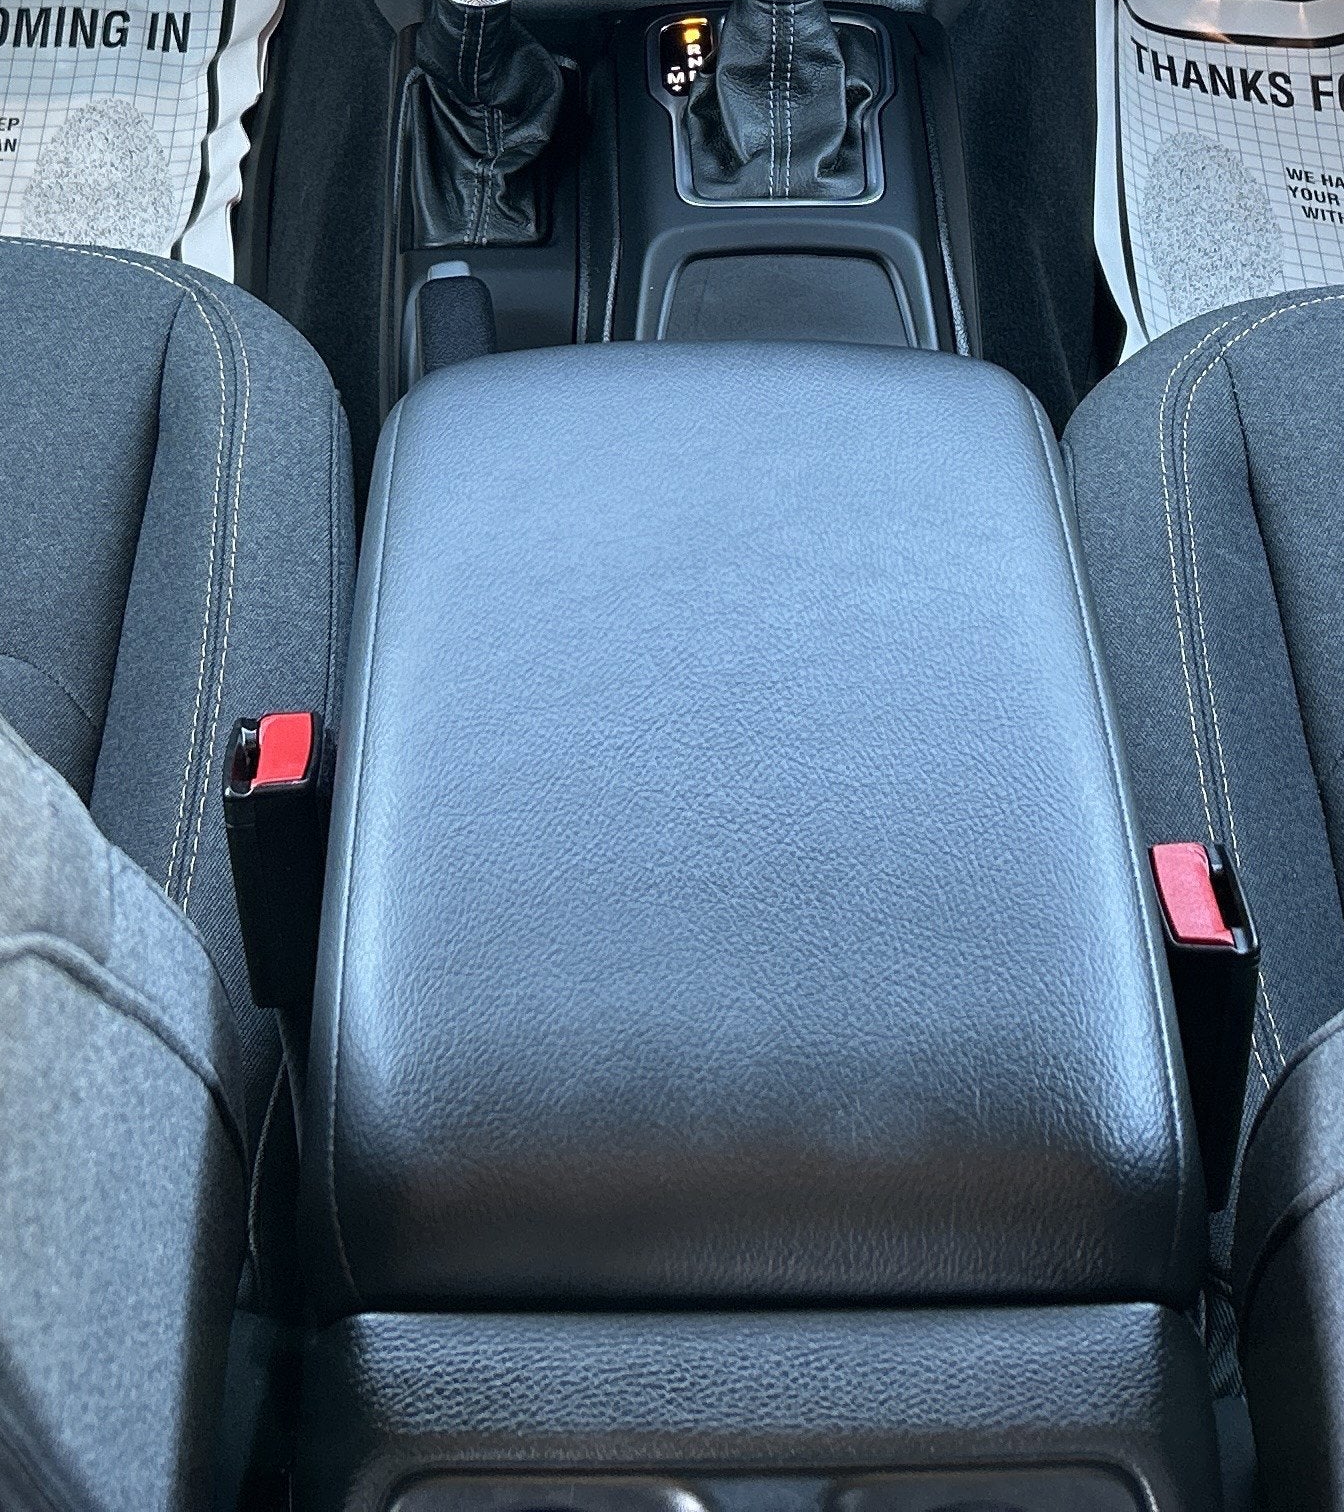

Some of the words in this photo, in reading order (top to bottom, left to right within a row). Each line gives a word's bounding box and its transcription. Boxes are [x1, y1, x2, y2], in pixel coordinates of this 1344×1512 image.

[146, 12, 191, 53] IN
[687, 44, 701, 55] R
[688, 56, 703, 69] N
[667, 72, 685, 85] M
[1130, 36, 1293, 108] THANKS
[1285, 167, 1315, 184] WE
[1288, 186, 1341, 207] YOUR
